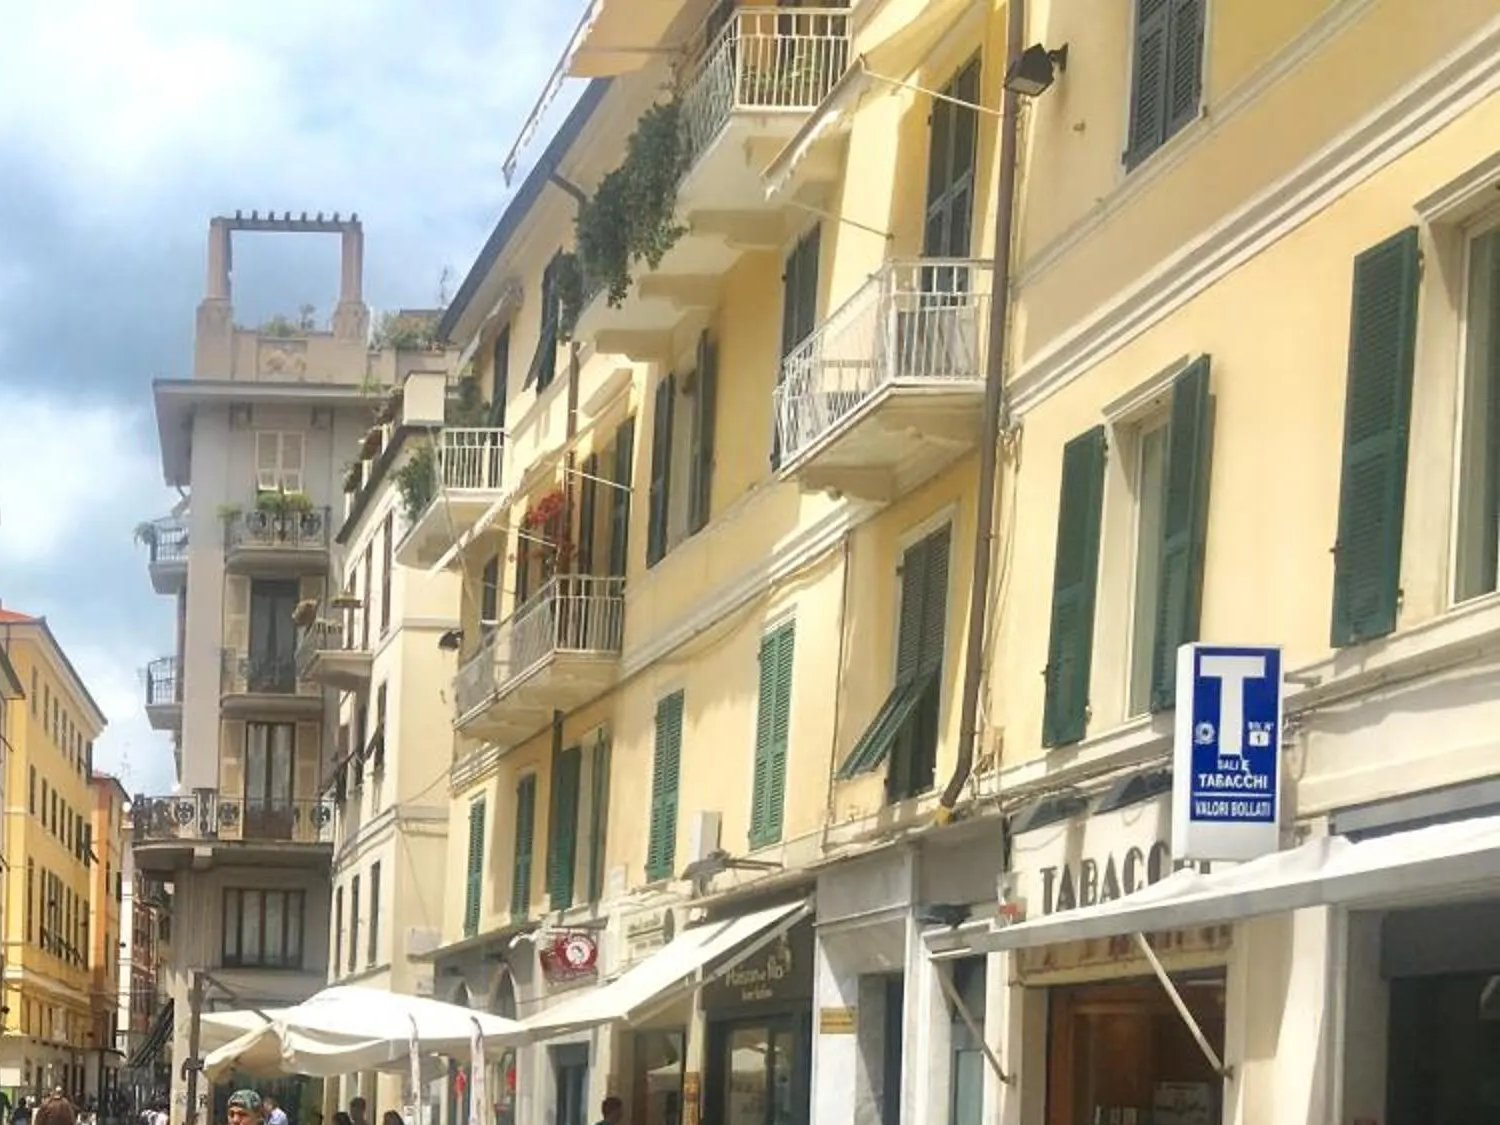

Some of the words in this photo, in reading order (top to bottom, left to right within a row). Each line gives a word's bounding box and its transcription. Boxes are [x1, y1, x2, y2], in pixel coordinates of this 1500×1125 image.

[1200, 656, 1266, 755] T
[1241, 758, 1251, 772] E
[1198, 773, 1268, 789] TABACCHI
[1195, 801, 1229, 817] VALORI
[1230, 801, 1271, 817] BOLLATI
